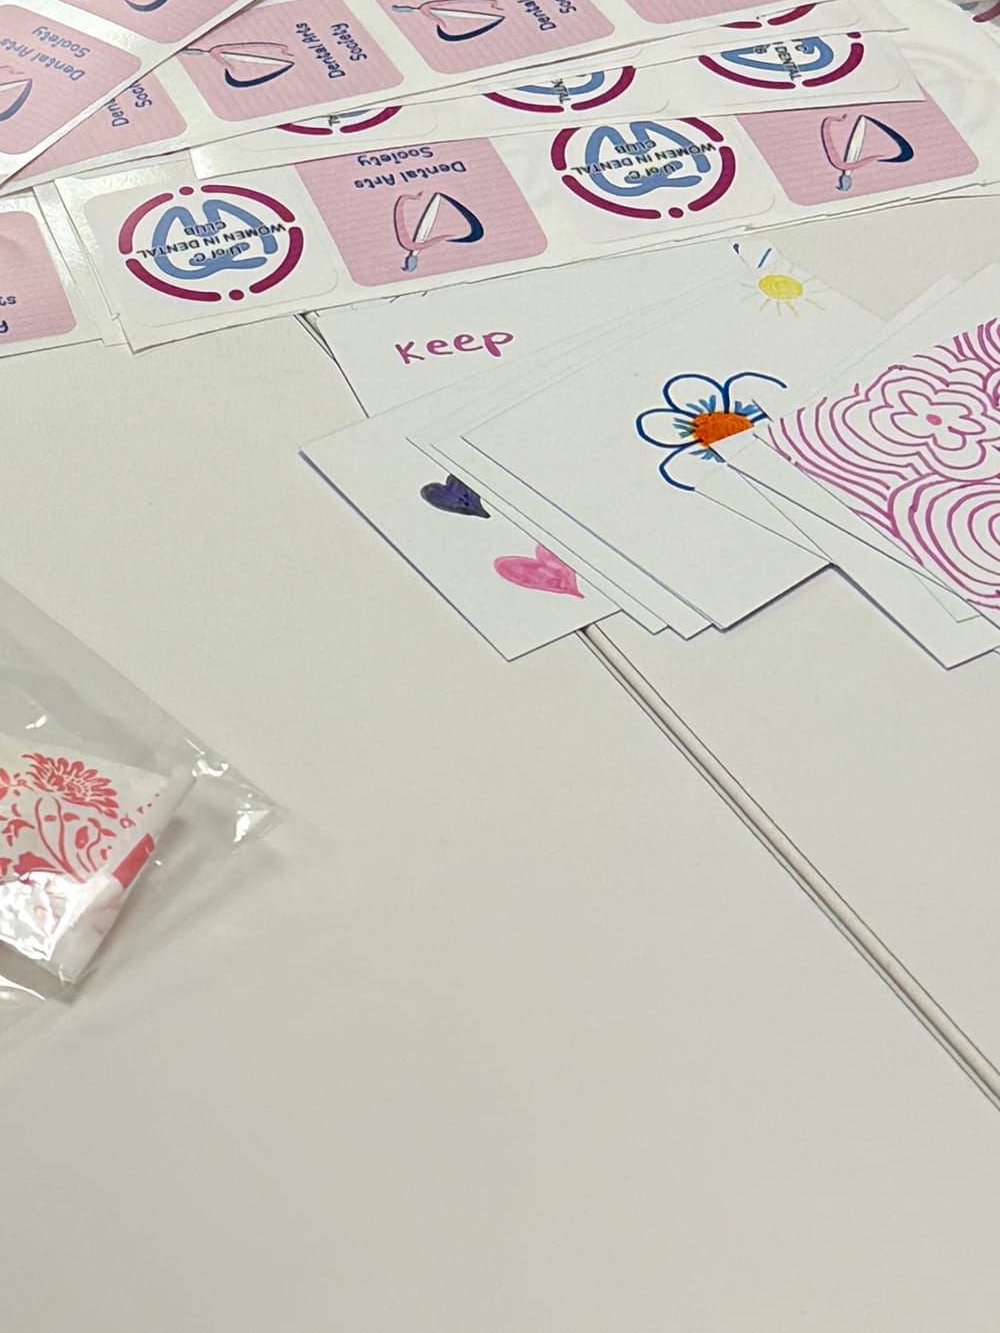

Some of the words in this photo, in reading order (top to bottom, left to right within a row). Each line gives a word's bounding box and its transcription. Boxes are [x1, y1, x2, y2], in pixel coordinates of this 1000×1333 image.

[31, 25, 90, 58] Society
[295, 22, 320, 43] Arts
[330, 22, 367, 61] Society
[29, 51, 86, 81] Dental
[307, 43, 346, 78] Dental
[356, 143, 434, 166] Society
[615, 140, 657, 154] CLUB
[655, 142, 716, 160] WOMEN
[571, 156, 633, 175] DENTAL
[637, 153, 653, 164] IN
[353, 173, 395, 189] Arts
[399, 160, 467, 182] Dental
[183, 220, 226, 236] CLUB
[222, 222, 286, 242] WOMEN
[135, 238, 197, 258] DENTAL
[201, 235, 217, 247] IN
